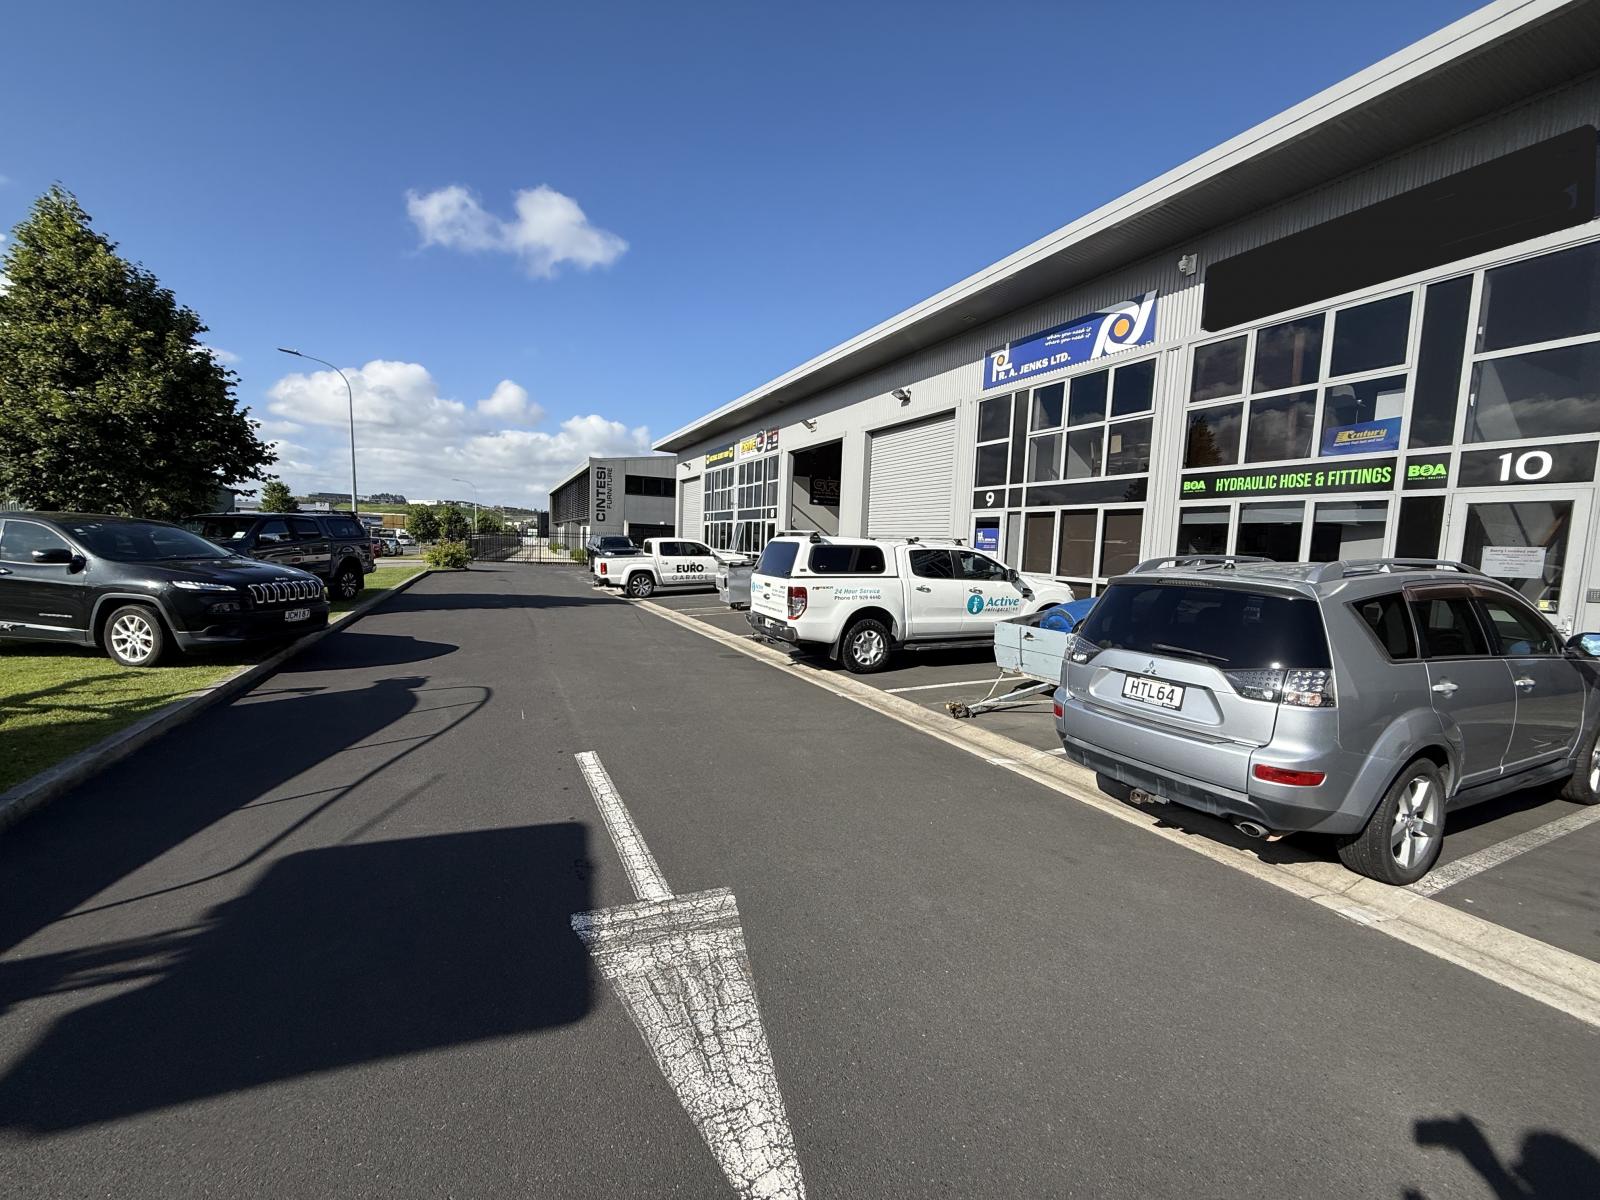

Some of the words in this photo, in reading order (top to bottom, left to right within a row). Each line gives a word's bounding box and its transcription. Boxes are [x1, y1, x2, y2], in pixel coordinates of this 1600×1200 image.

[999, 371, 1007, 380] R.
[1009, 368, 1018, 377] A.
[1019, 358, 1048, 374] JENKS
[1050, 352, 1071, 365] LTD.
[1408, 463, 1447, 477] BOA
[1499, 450, 1553, 482] 10
[1183, 480, 1206, 490] BOA
[1215, 474, 1278, 492] HYDRAULIC
[1279, 472, 1313, 488] HOSE
[1315, 472, 1325, 487] &
[1327, 466, 1392, 486] FITTINGS
[596, 466, 606, 522] CINTESI
[985, 491, 995, 507] 9
[770, 508, 775, 518] 8
[676, 564, 704, 573] EURO
[985, 595, 1020, 607] Active
[1130, 680, 1175, 703] HTL64
